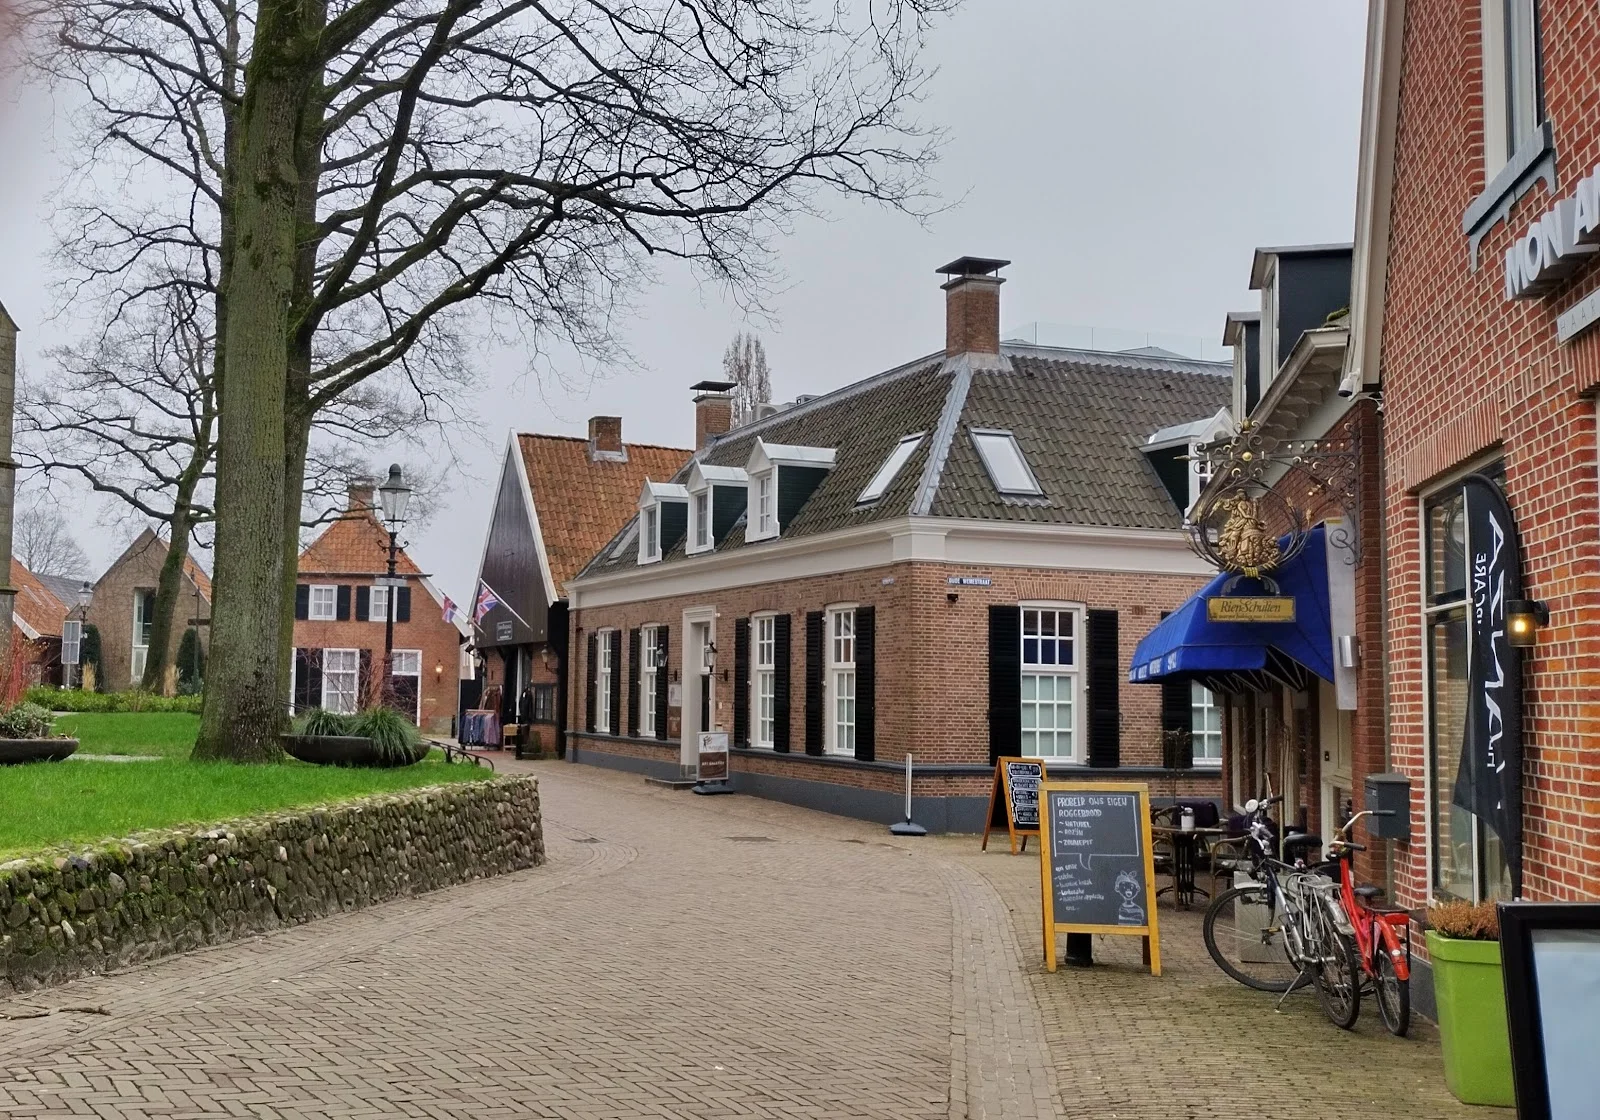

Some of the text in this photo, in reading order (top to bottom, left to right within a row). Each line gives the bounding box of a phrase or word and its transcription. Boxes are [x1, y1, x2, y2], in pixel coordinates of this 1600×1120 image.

[1505, 199, 1563, 302] MON
[1088, 797, 1104, 806] ONS
[1107, 797, 1127, 807] EIGEN
[1058, 808, 1102, 818] ROGGEBROOD
